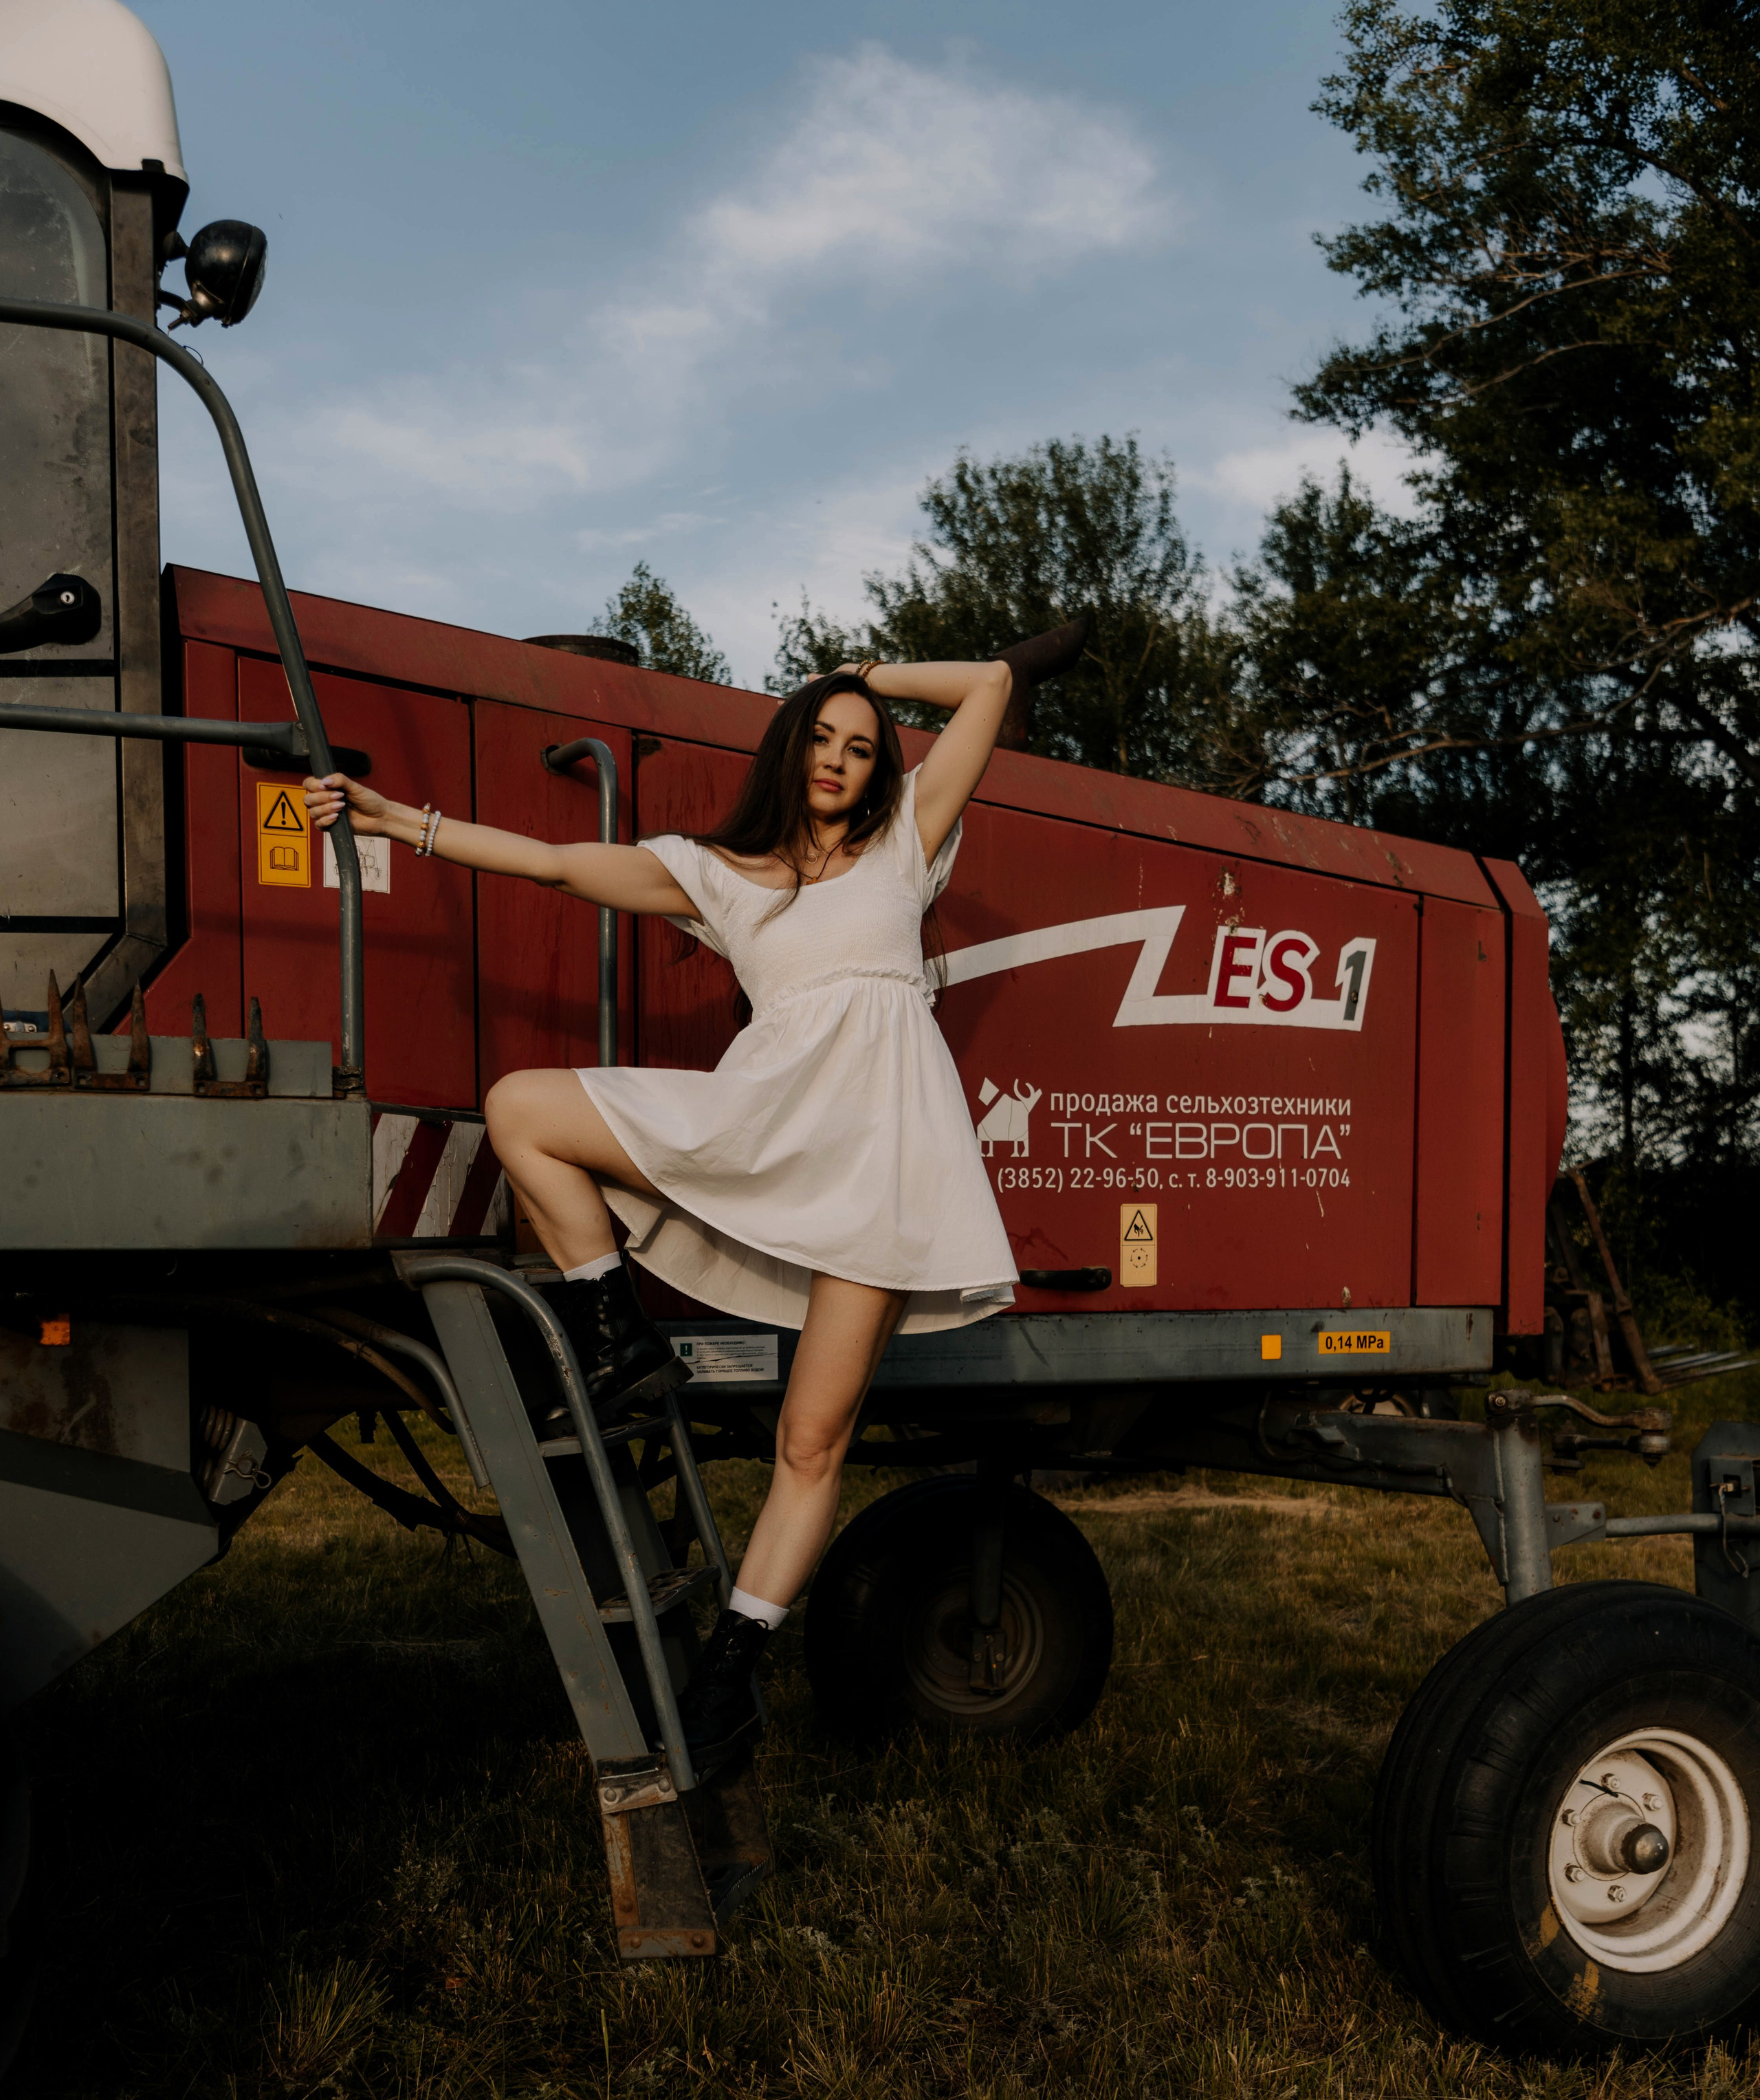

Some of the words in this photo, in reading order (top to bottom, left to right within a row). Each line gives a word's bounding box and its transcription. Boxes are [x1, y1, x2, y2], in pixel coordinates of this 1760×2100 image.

[1341, 948, 1370, 1023] 1
[1050, 1093, 1158, 1119] продажа
[1166, 1095, 1351, 1116] сельхозтехники
[1050, 1122, 1118, 1159] ТК
[998, 1168, 1064, 1193] (3852)
[1070, 1168, 1163, 1190] 22-96-50,
[1206, 1168, 1350, 1188] 8-903-911-0704
[1325, 1335, 1352, 1352] 0,14
[1356, 1335, 1384, 1349] MPa
